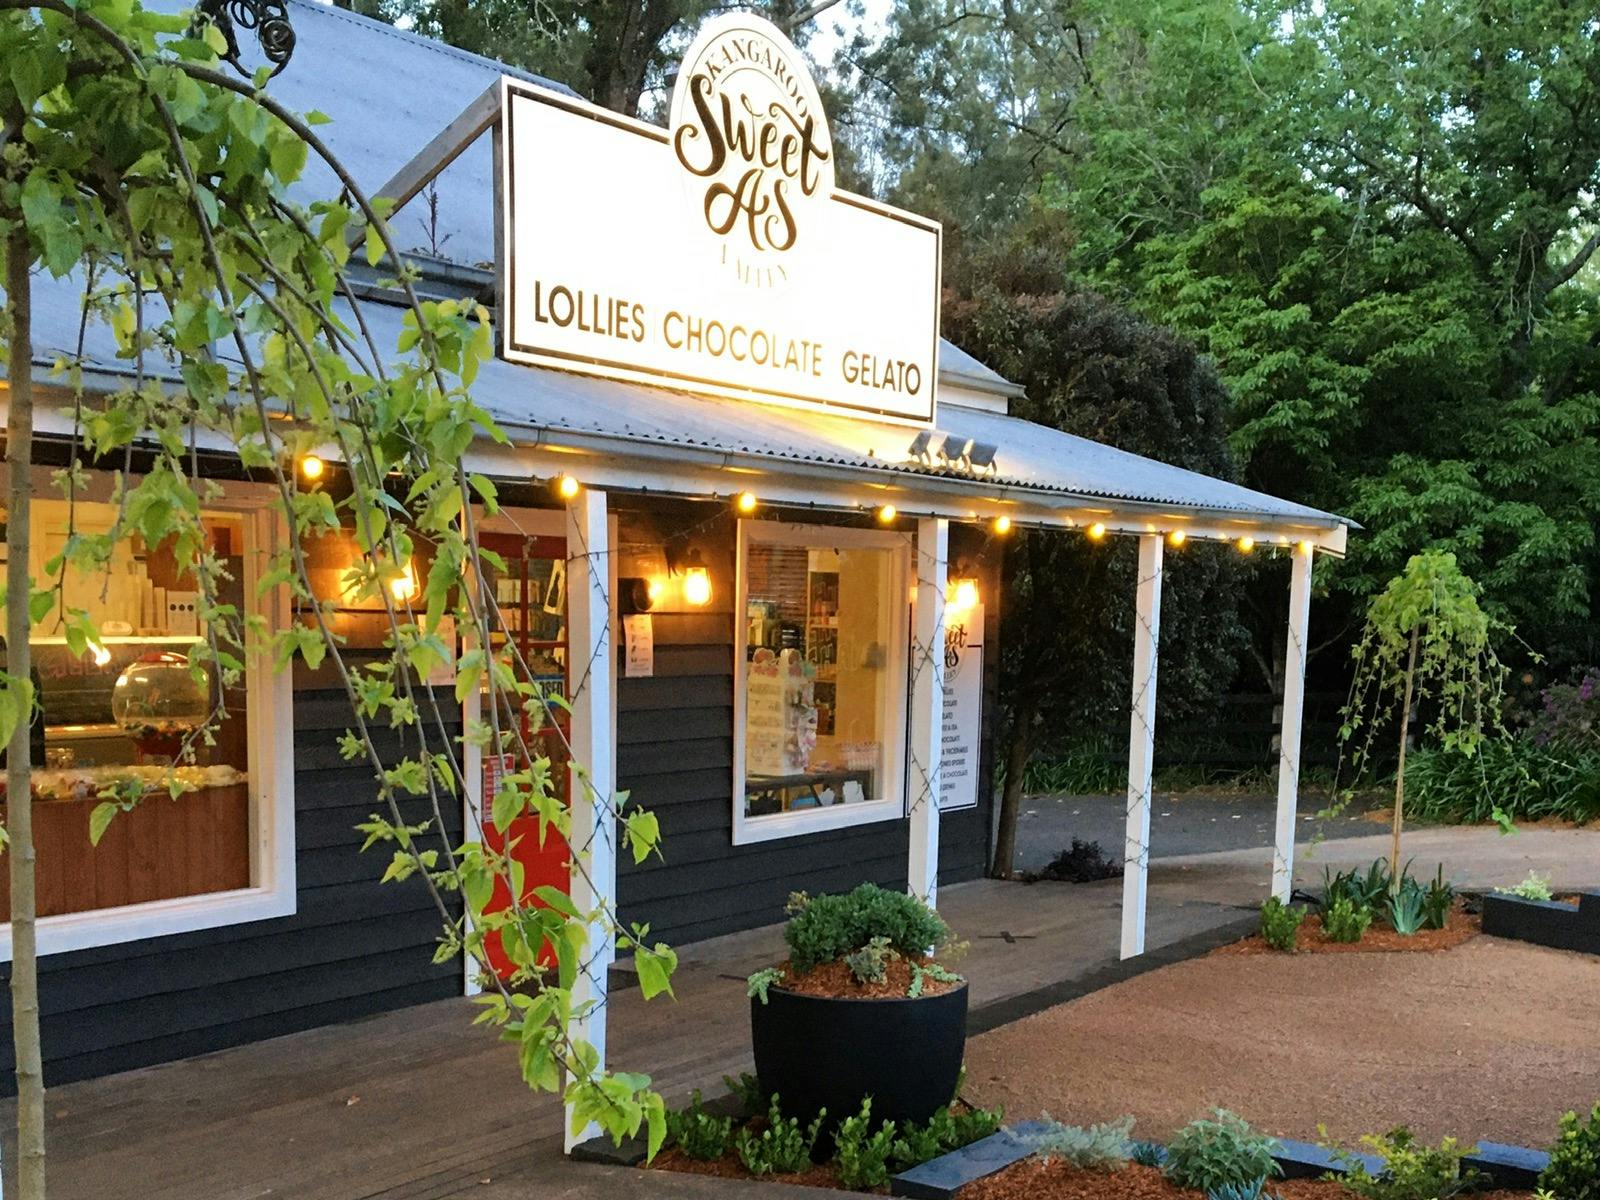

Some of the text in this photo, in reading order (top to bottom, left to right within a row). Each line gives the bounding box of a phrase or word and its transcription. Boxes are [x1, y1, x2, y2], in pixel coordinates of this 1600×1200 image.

[705, 38, 808, 118] KANGAROO
[674, 73, 828, 196] Sweet
[534, 280, 921, 396] LOLLIES CHOCOLATE GELATO
[944, 624, 968, 648] eet
